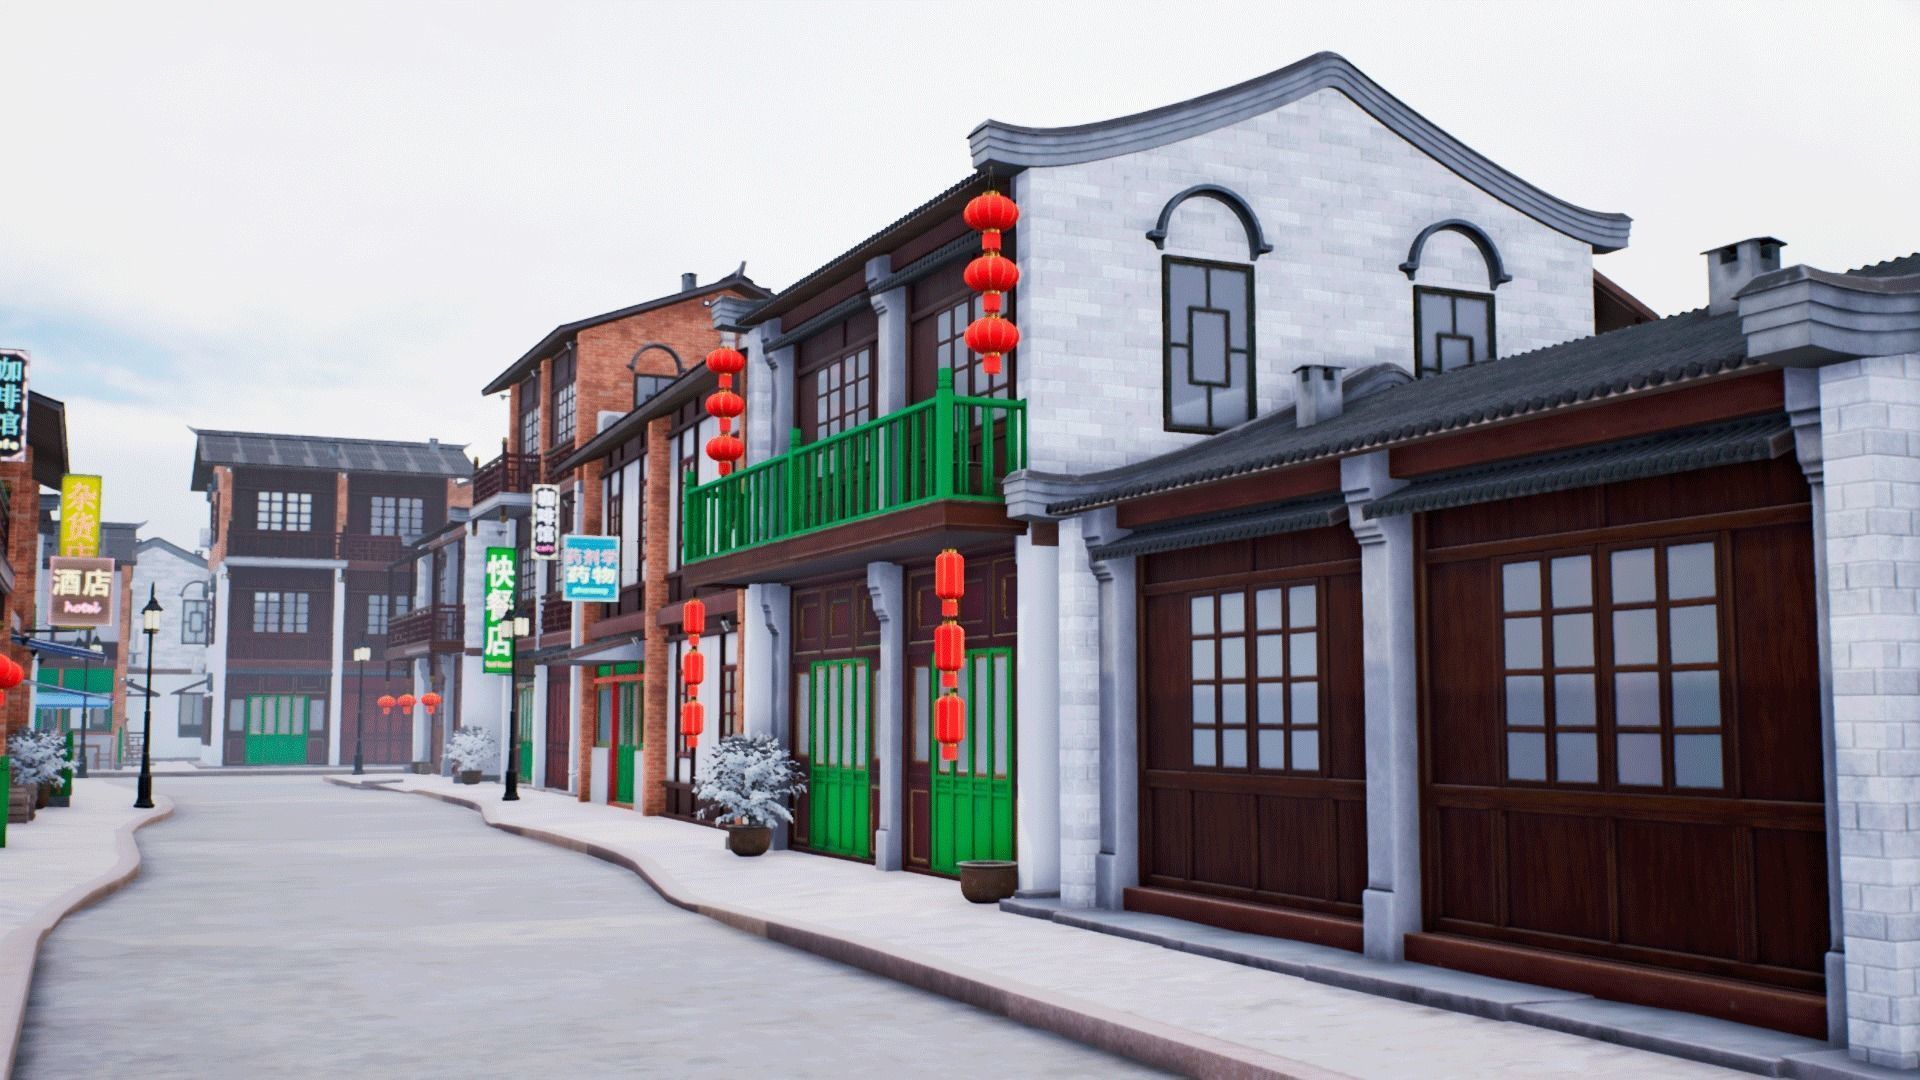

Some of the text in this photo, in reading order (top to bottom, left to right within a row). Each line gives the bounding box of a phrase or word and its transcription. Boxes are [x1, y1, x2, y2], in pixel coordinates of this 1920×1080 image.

[52, 568, 113, 598] 酒店
[566, 565, 616, 584] 药物
[486, 554, 515, 657] 快餐店
